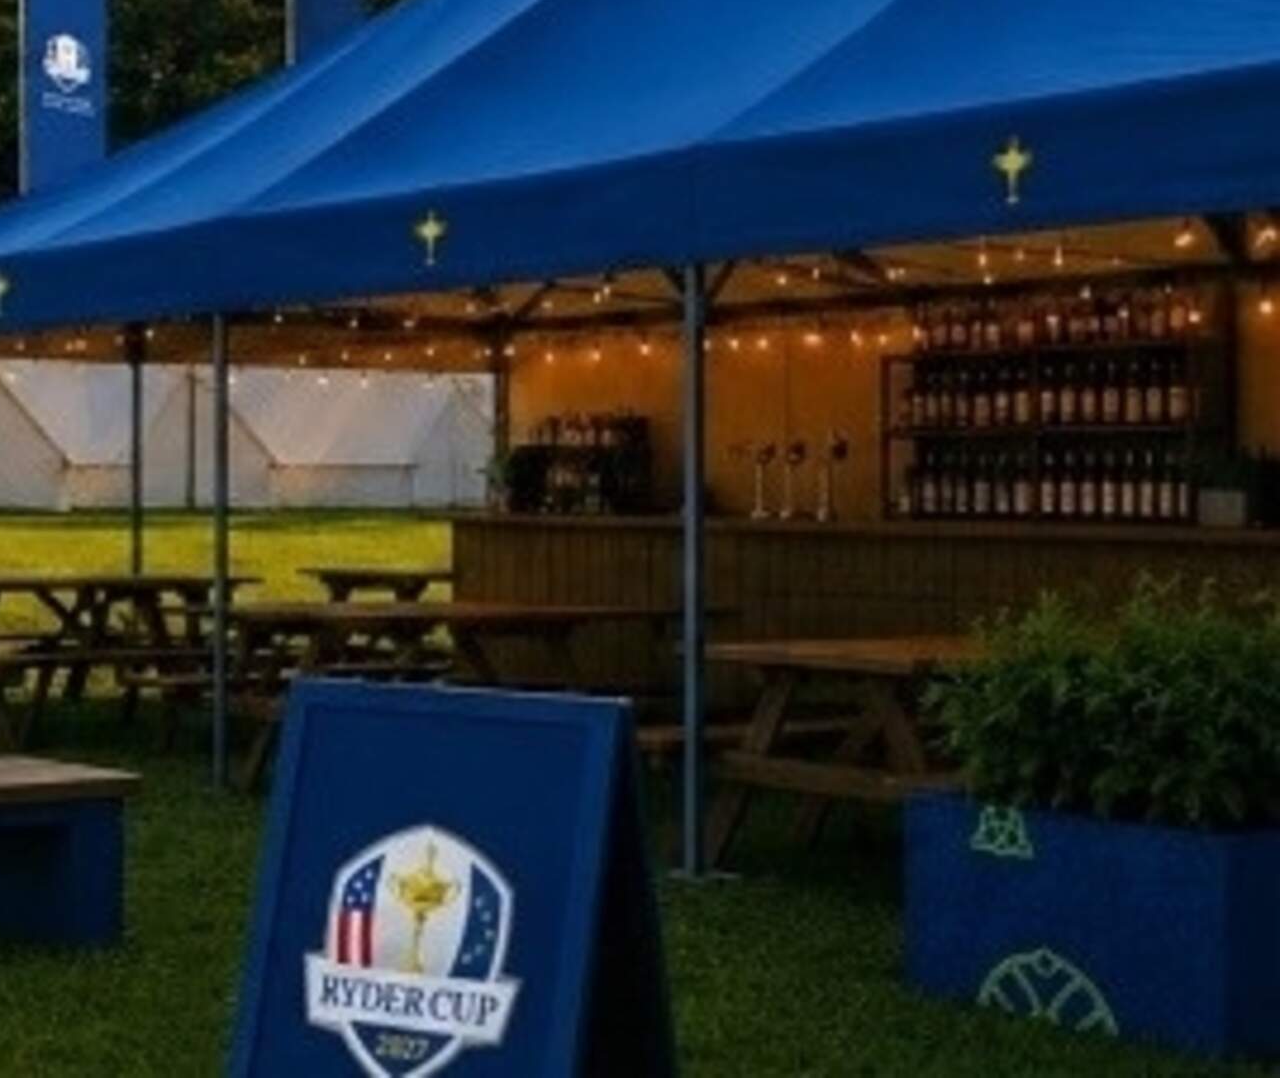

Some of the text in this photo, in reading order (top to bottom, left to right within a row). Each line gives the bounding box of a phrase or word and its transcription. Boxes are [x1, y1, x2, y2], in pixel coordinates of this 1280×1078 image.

[320, 974, 499, 1026] RYDER CUP
[375, 1033, 429, 1061] 2027
